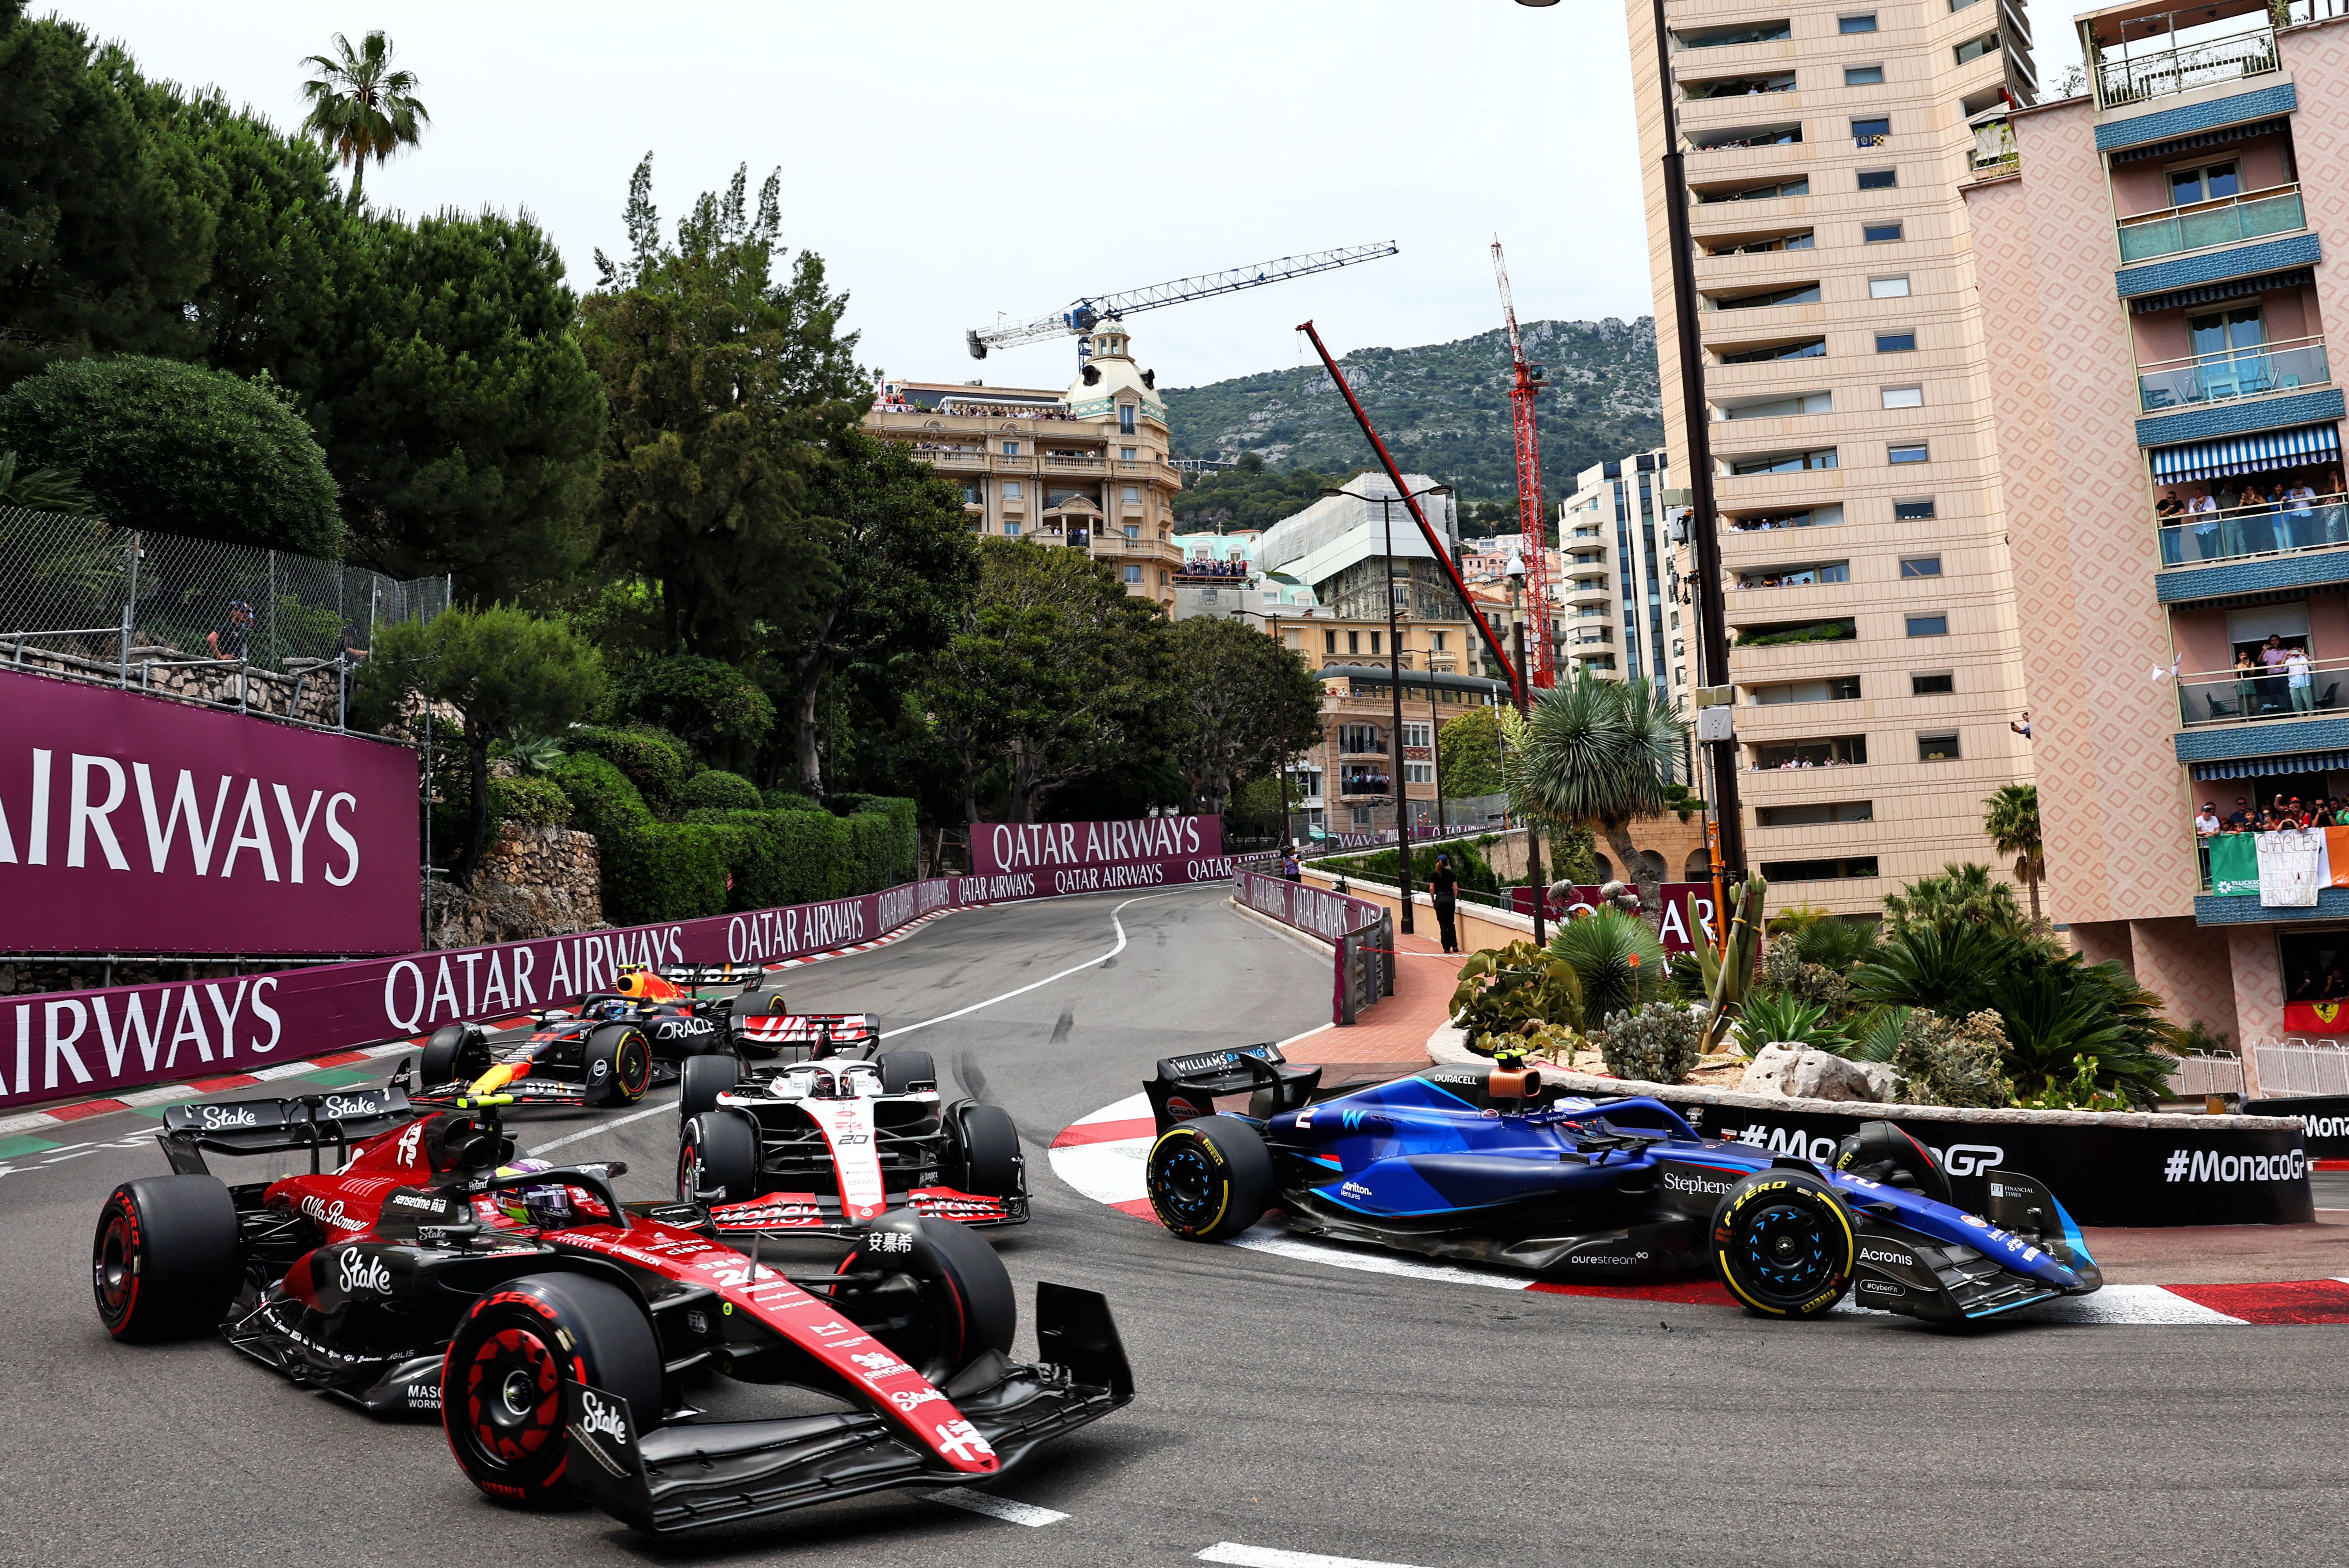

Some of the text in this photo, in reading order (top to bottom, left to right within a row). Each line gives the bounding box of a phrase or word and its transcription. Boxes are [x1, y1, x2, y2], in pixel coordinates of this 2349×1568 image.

[0, 747, 359, 887] IRWAYS
[993, 816, 1201, 873] QATAR AIRWAYS
[2257, 833, 2319, 852] CHARLES
[1187, 858, 1233, 882] QATAR
[2262, 851, 2316, 871] PIERRE
[959, 873, 1035, 905] QATAR AIRWAYS
[1055, 864, 1163, 893] QATAR AIRWAYS
[879, 891, 897, 933] QATAR
[1293, 886, 1347, 939] QATAR AIRWAYS
[728, 901, 864, 963] QATAR AIRWAYS
[384, 925, 683, 1035] QATAR AIRWAYS
[0, 977, 281, 1095] IRWAYS
[530, 1032, 560, 1041] 11
[656, 1018, 714, 1039] ORACLE
[1176, 1054, 1227, 1071] WILLIAMS
[1434, 1074, 1476, 1085] DURACELL
[203, 1105, 256, 1129] Stake
[325, 1095, 377, 1119] Stake
[1169, 1106, 1200, 1116] Gulf
[1296, 1108, 1320, 1129] 2
[1546, 1114, 1567, 1122] Jumeirah
[838, 1134, 869, 1145] 20
[1202, 1138, 1224, 1166] PIRELLI
[576, 1163, 608, 1173] Stake
[2164, 1148, 2305, 1182] #MonacoGP
[468, 1179, 489, 1192] Hyland
[1664, 1173, 1732, 1195] Stephens
[1841, 1174, 1881, 1189] 2
[1992, 1185, 2002, 1193] FT
[393, 1195, 430, 1210] sensetime
[1341, 1189, 1361, 1200] Ventures
[1724, 1181, 1787, 1227] P ZERO
[301, 1195, 369, 1231] Alfa Romeo
[716, 1204, 821, 1226] Money
[909, 1193, 995, 1219] Gram
[122, 1195, 140, 1245] ZERO
[419, 1226, 446, 1240] Stake
[557, 1237, 594, 1250] EYEWEAR
[868, 1232, 913, 1252] 安慕希
[486, 1247, 538, 1256] CAMOZZI
[618, 1246, 663, 1266] REBELLION
[666, 1245, 713, 1255] cielo
[1572, 1254, 1637, 1264] purestream
[1859, 1248, 1913, 1266] Acronis
[339, 1247, 392, 1295] Stake
[712, 1264, 776, 1287] 24
[1867, 1283, 1898, 1293] #CyberFit
[488, 1291, 558, 1319] ZERO
[1801, 1288, 1838, 1313] PIRELLI
[387, 1349, 414, 1361] AGILIS
[863, 1364, 916, 1379] SINGHA
[891, 1388, 948, 1412] Stake
[583, 1391, 626, 1445] Stake
[482, 1480, 525, 1499] PIRELLI
